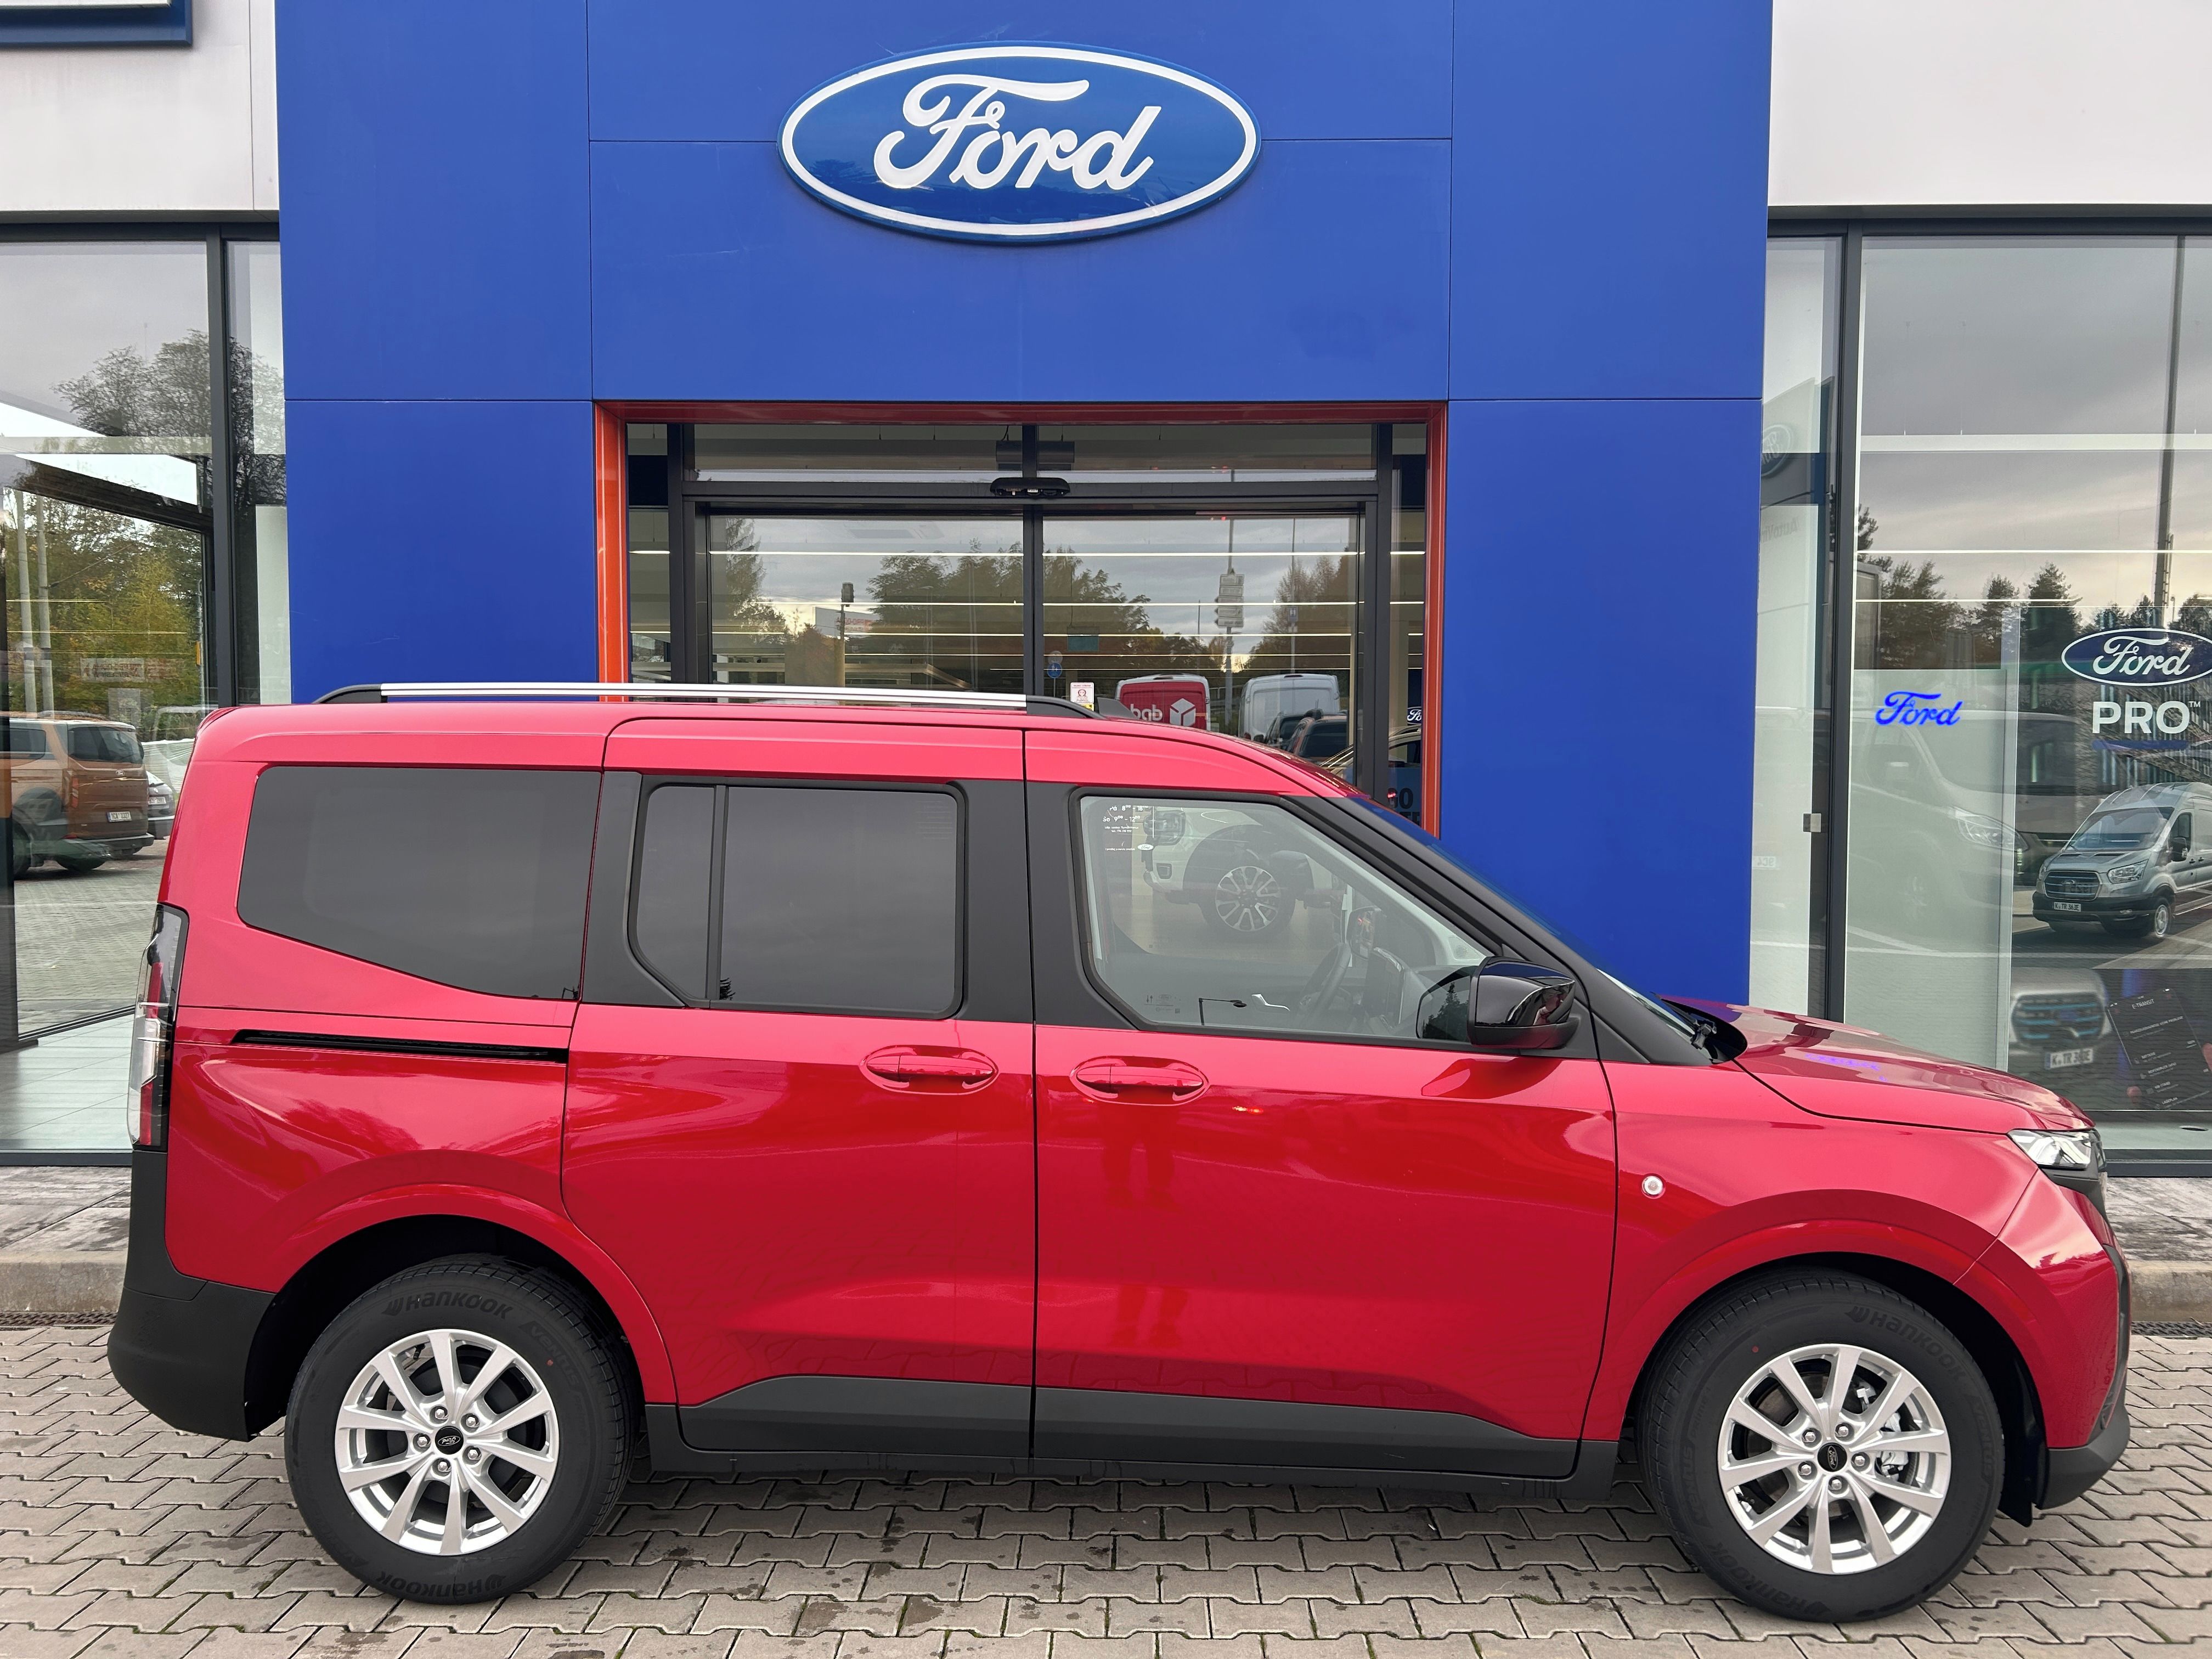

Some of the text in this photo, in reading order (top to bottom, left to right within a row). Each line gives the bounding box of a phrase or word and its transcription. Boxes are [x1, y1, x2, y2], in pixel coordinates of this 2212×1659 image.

[873, 74, 1162, 190] Ford
[2092, 636, 2194, 675] Ford
[1407, 709, 1422, 721] Fo
[1875, 691, 1963, 726] Ford
[441, 1436, 456, 1445] Ford
[1829, 1450, 1837, 1466] Ford
